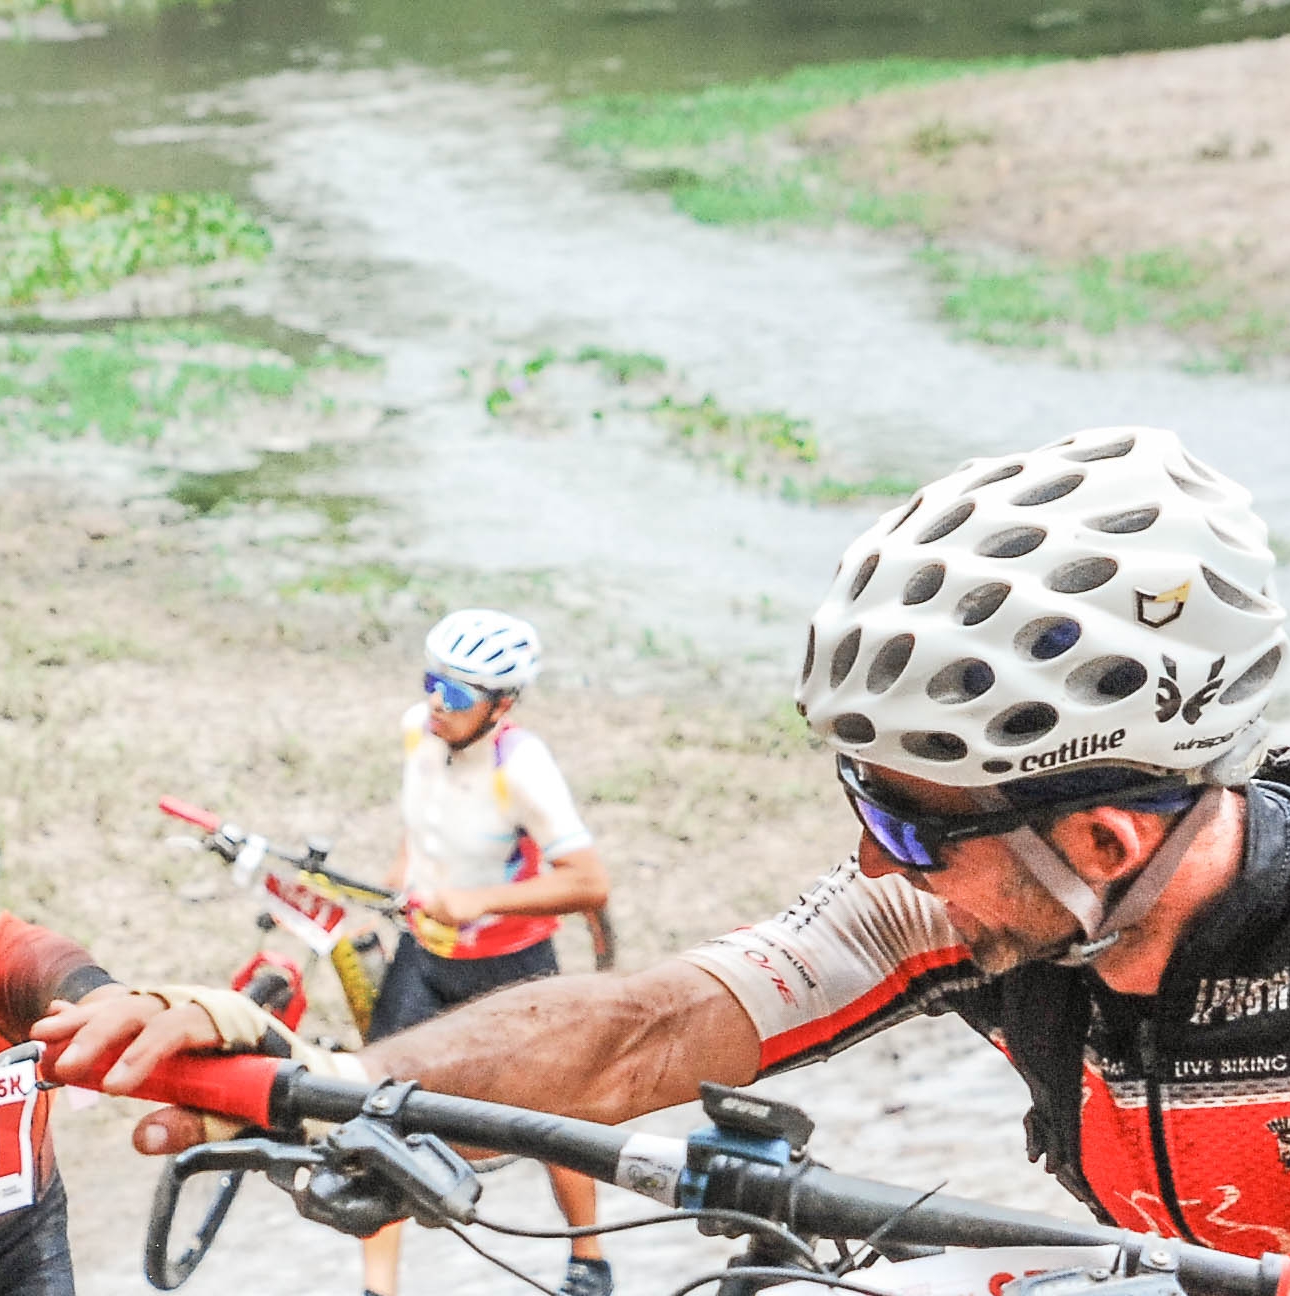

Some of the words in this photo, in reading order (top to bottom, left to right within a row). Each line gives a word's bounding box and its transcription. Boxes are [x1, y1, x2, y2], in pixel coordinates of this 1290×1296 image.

[1019, 728, 1126, 772] catlike
[1174, 1060, 1213, 1078] LIVE
[1220, 1055, 1287, 1074] BIKING
